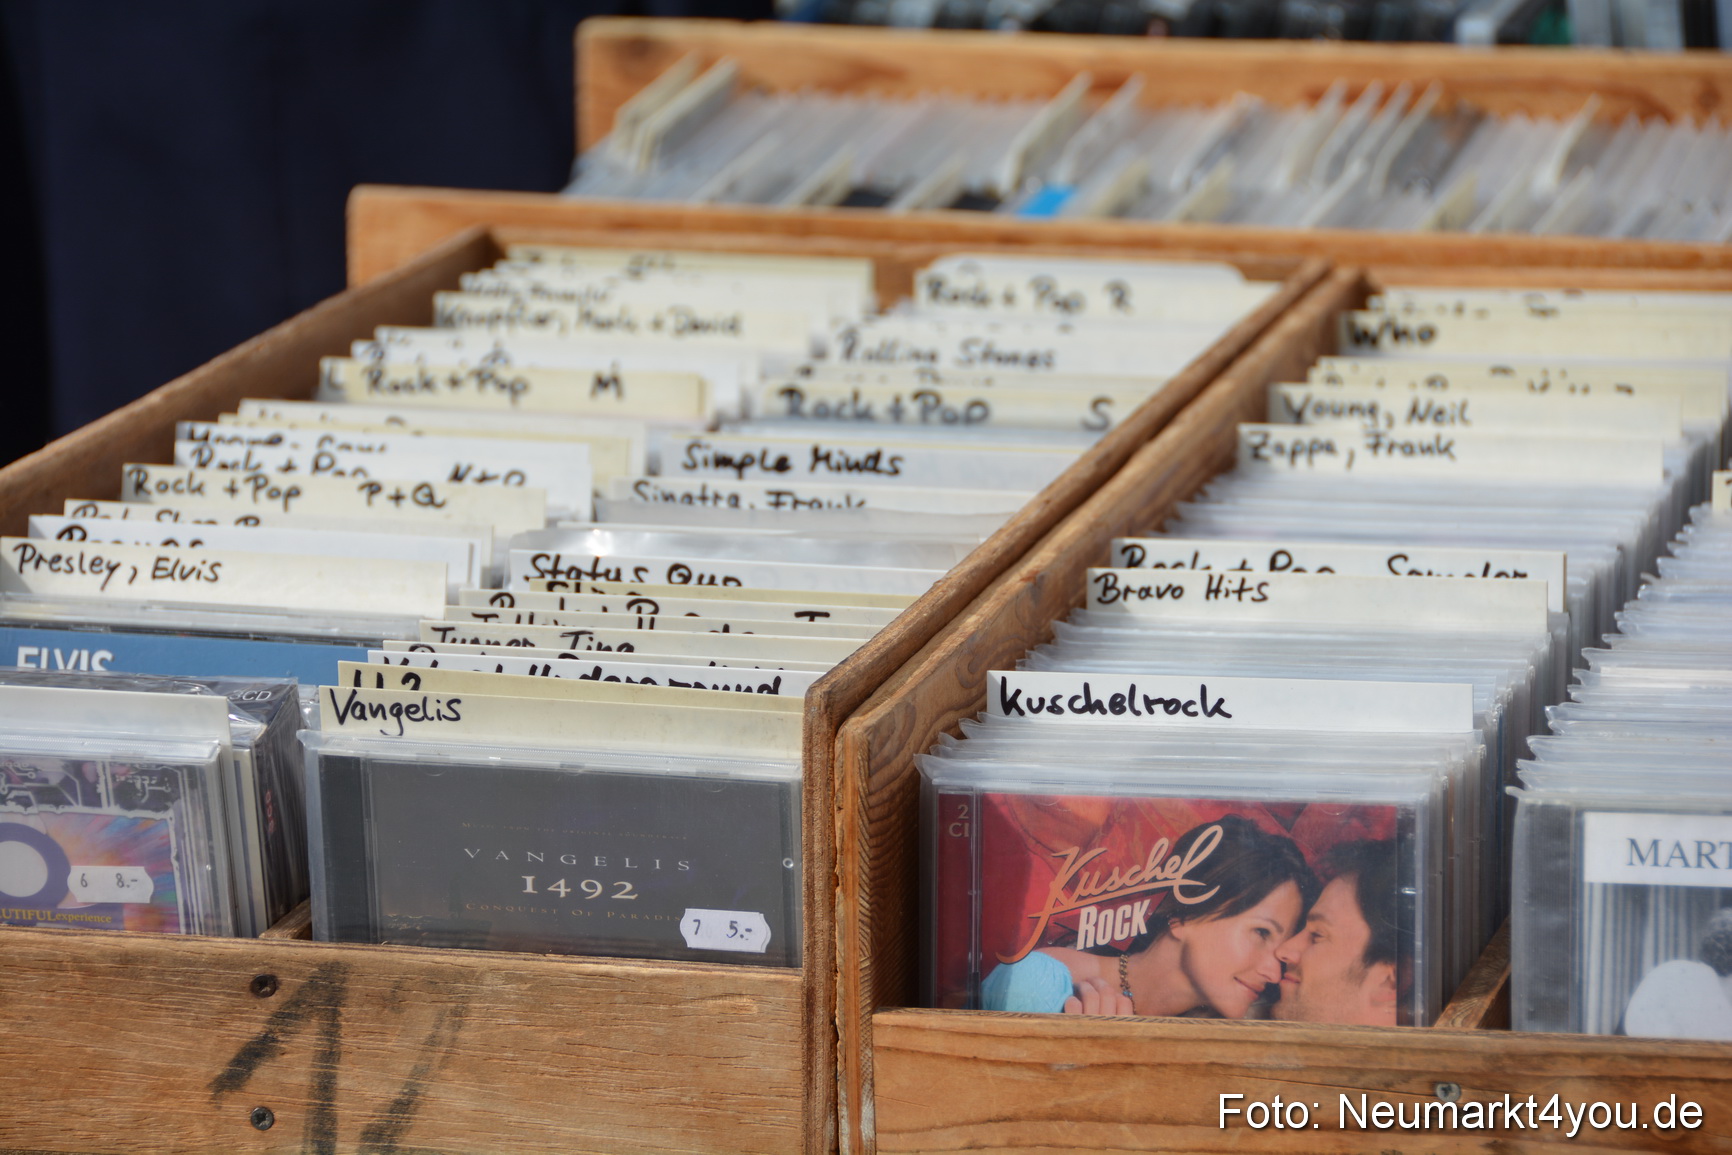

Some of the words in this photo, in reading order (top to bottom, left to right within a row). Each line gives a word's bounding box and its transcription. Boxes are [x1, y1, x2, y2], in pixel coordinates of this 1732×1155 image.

[957, 337, 1056, 369] Stones
[466, 366, 530, 408] Pop
[590, 361, 625, 401] M
[779, 385, 876, 419] Rock
[913, 389, 991, 426] Pop
[1082, 396, 1115, 432] S
[1405, 397, 1472, 427] Neil
[1365, 429, 1458, 460] Frank
[682, 441, 793, 480] Simple
[809, 444, 906, 477] Minds
[128, 467, 206, 497] Rock
[243, 475, 303, 514] Pop
[151, 556, 223, 582] Elvis
[523, 553, 650, 584] Status
[1094, 572, 1184, 604] Bravo
[1204, 573, 1270, 603] Hits
[329, 687, 462, 737] Vangelis
[1000, 676, 1233, 719] Kuschelrock
[957, 804, 970, 820] 2
[464, 848, 690, 871] VANGELIS
[80, 873, 89, 888] 6
[521, 875, 639, 901] 1492
[996, 825, 1224, 964] Kuschel
[607, 911, 681, 922] PARADIS
[693, 918, 701, 935] 7
[1077, 899, 1150, 951] ROCK
